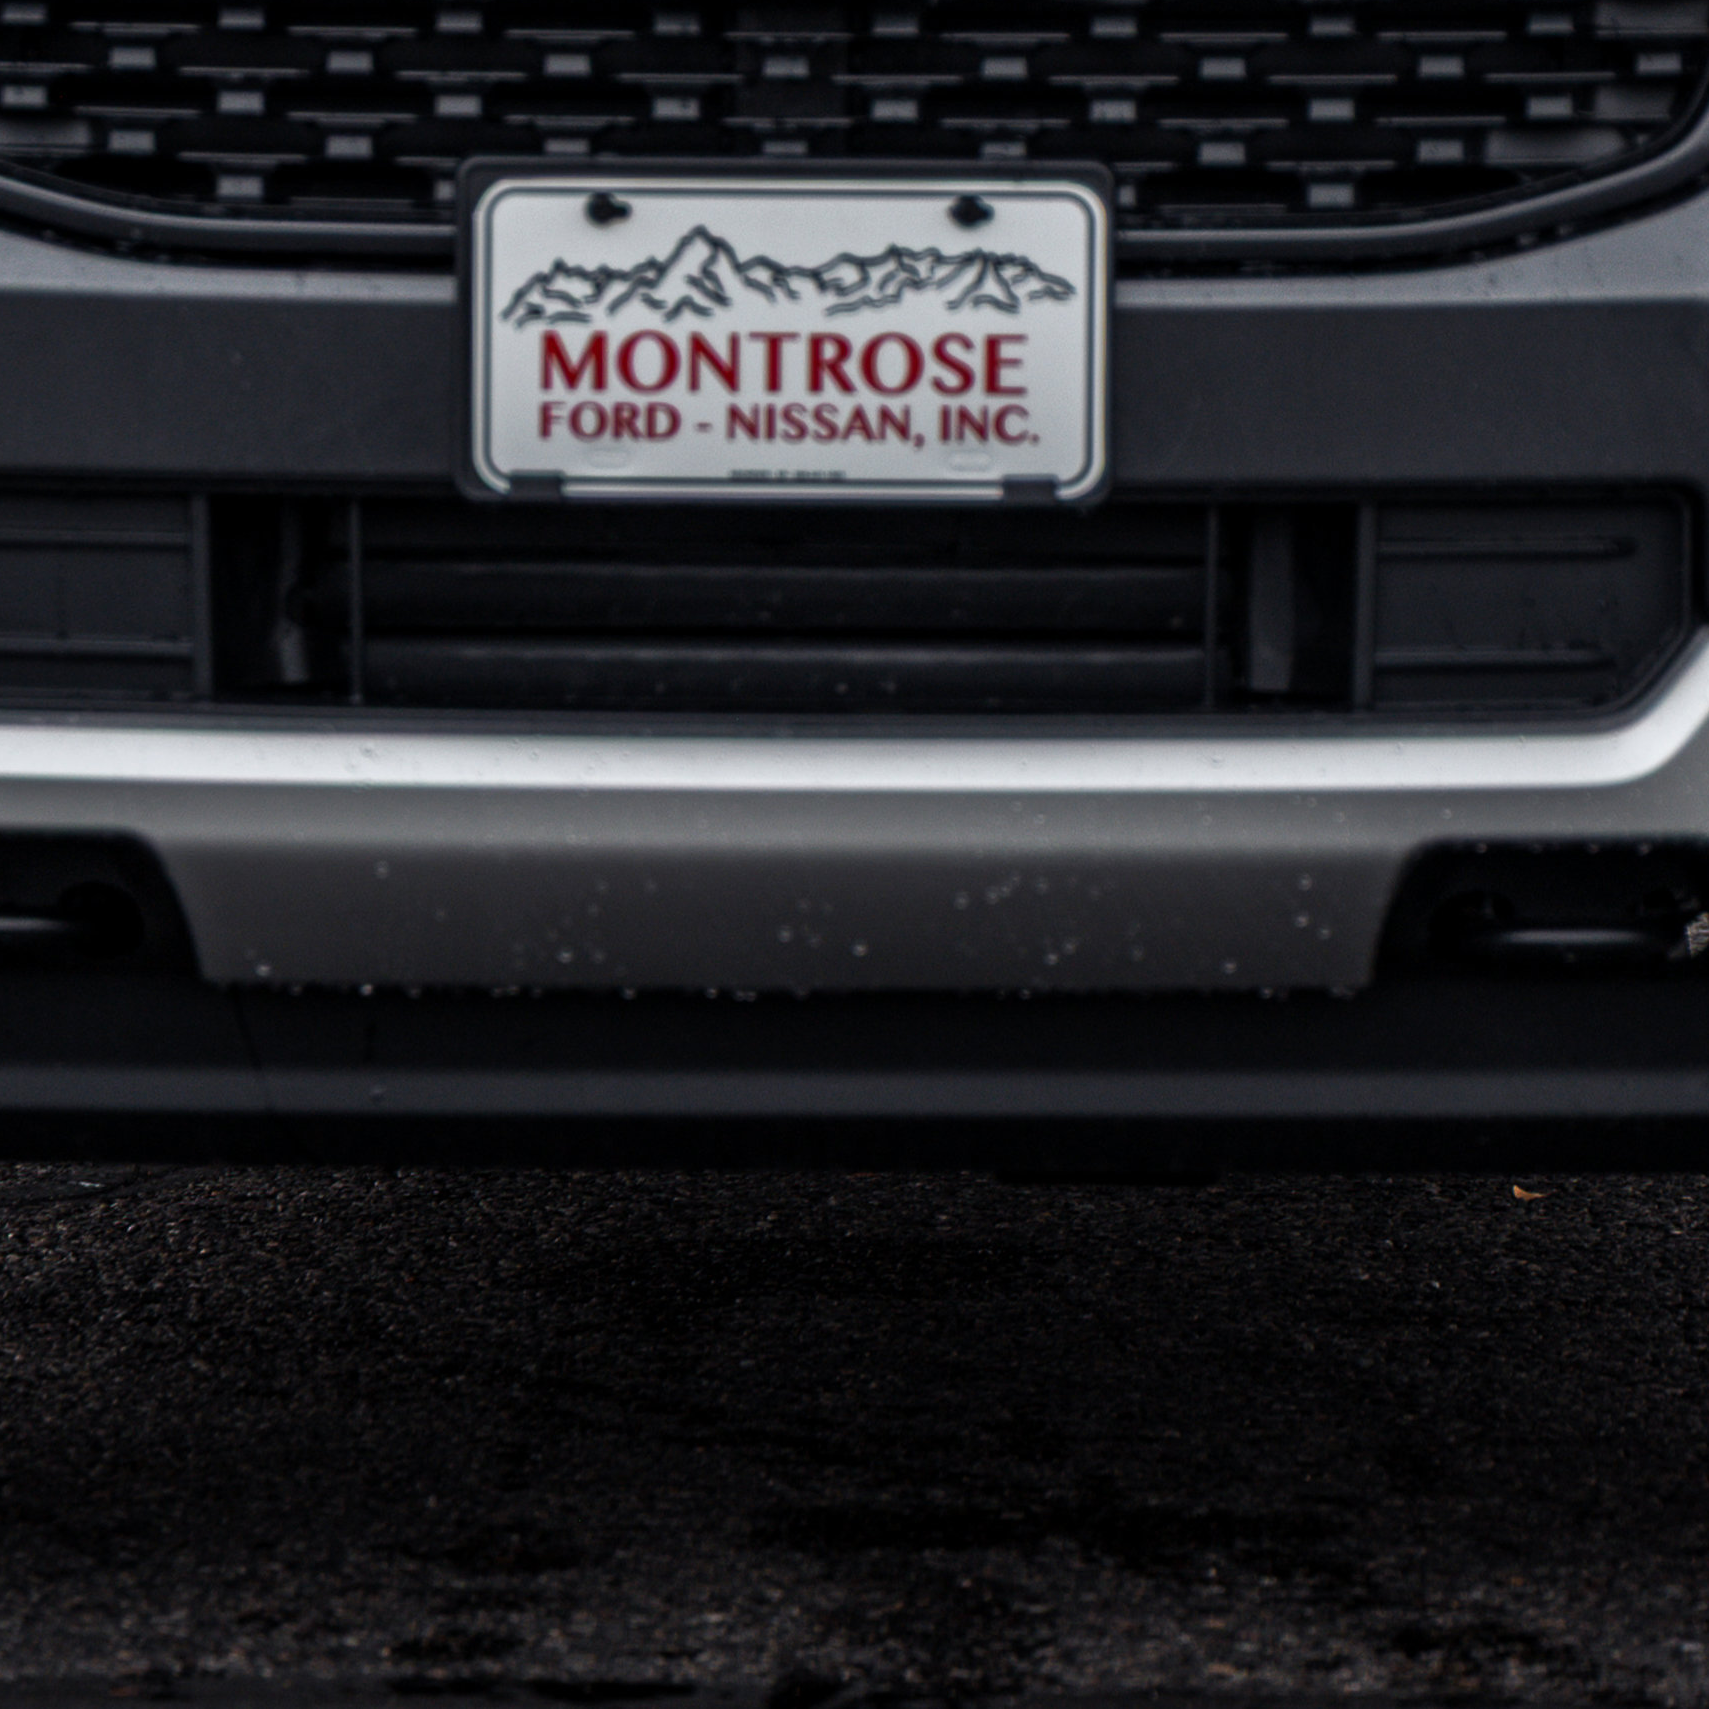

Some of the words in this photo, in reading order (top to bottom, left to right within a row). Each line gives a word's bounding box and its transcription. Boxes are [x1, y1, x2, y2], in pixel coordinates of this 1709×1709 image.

[539, 329, 1029, 395] MONTROSE
[538, 400, 682, 442] FORD
[726, 402, 926, 449] NISSAN,
[939, 404, 1041, 445] INC.
